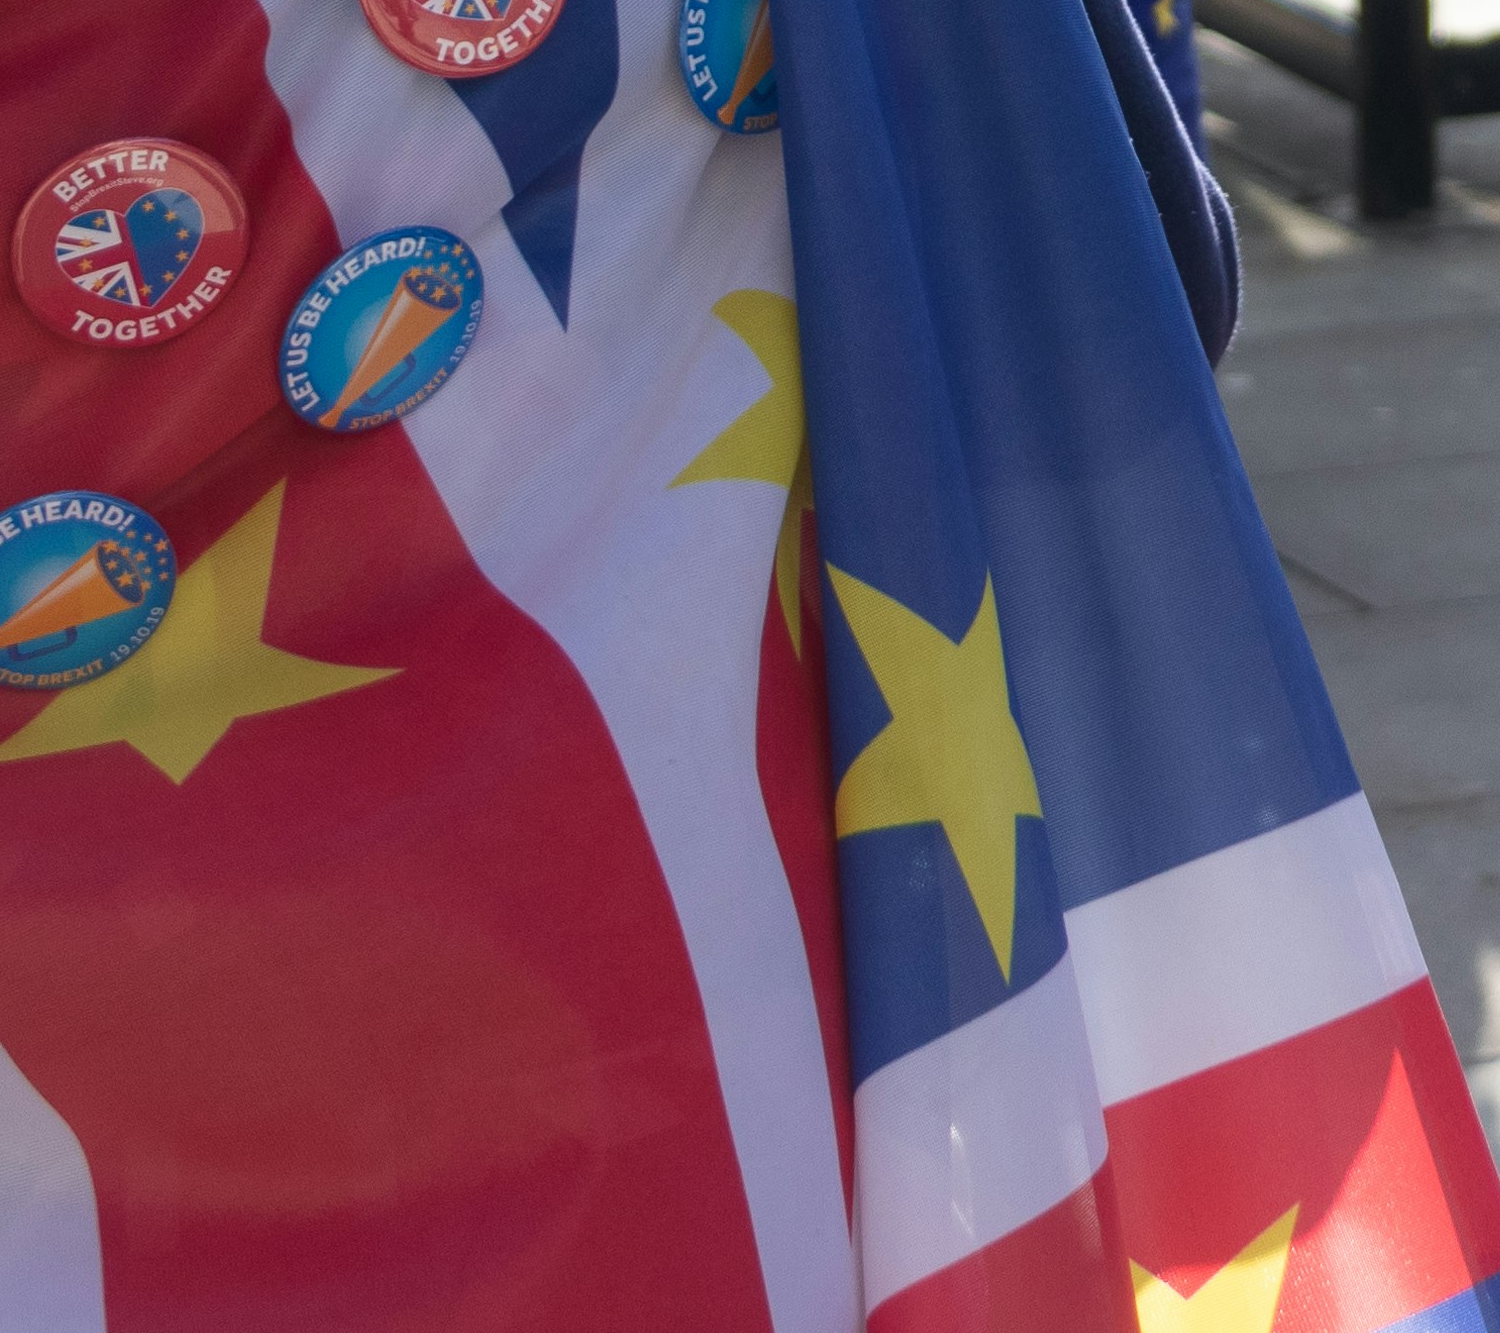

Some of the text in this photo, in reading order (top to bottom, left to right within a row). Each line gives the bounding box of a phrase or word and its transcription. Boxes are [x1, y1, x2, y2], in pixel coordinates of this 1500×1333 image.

[687, 8, 707, 46] US
[689, 54, 719, 101] LET
[52, 149, 170, 203] BETTER
[71, 265, 233, 341] TOGETHER
[286, 236, 427, 412] LET US BE HEARD!
[20, 499, 136, 533] HEARD!
[37, 658, 105, 687] BREXIT
[109, 606, 166, 663] 19.10.19
